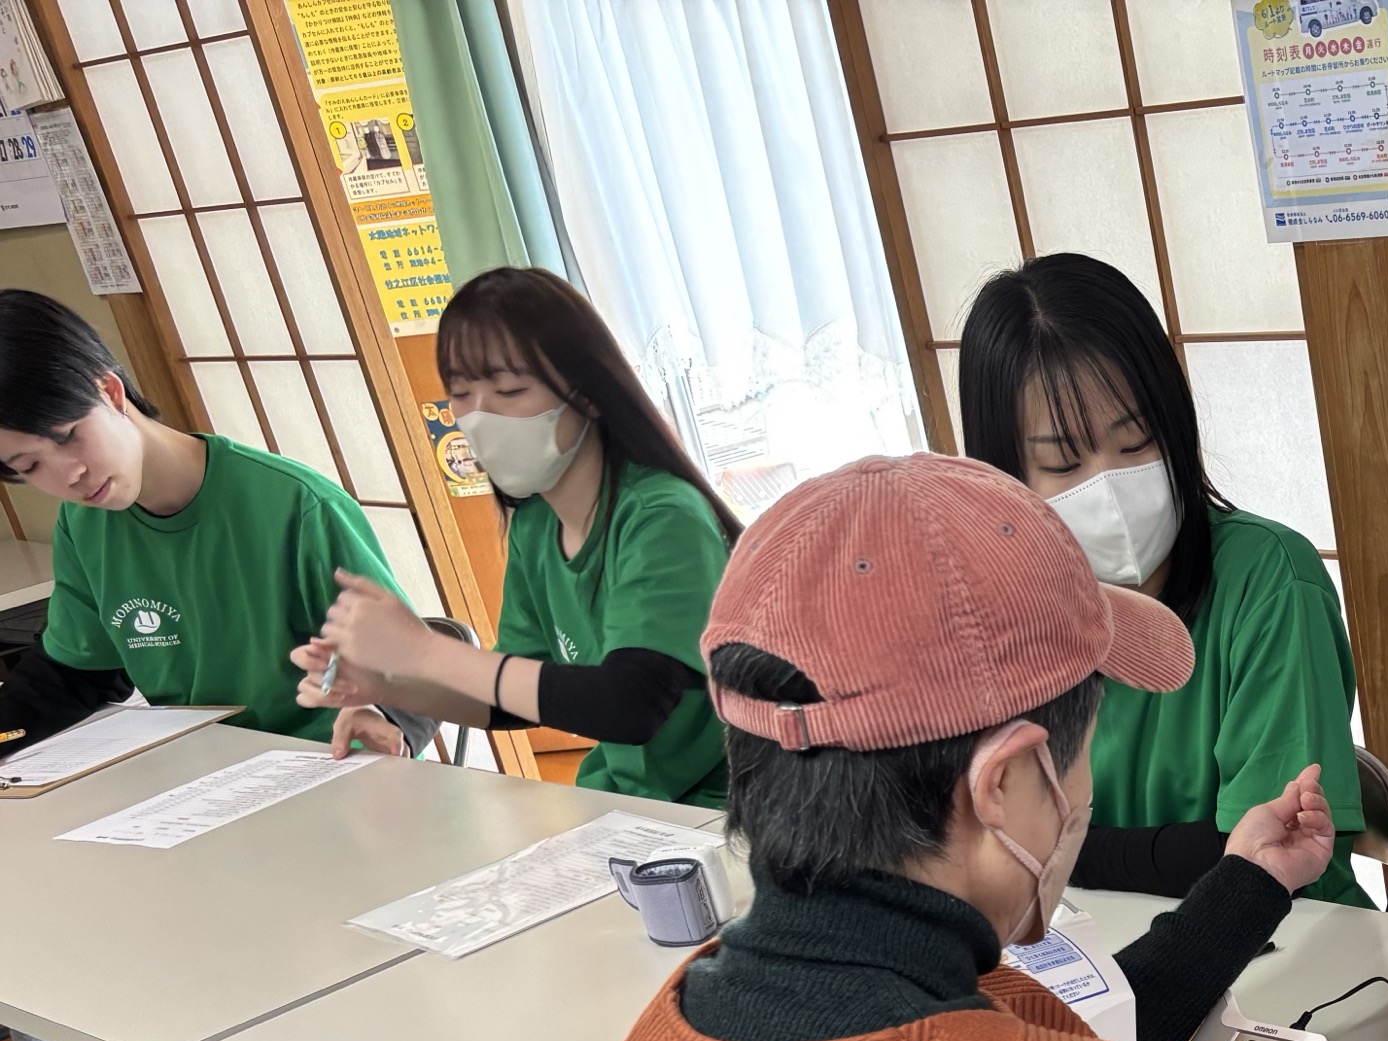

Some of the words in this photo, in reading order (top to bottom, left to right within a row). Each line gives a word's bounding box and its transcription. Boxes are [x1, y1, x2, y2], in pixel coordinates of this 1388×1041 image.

[1263, 45, 1301, 63] 時刻表
[8, 137, 24, 161] 28
[21, 135, 37, 159] 29
[111, 598, 181, 628] MORINOMIYA
